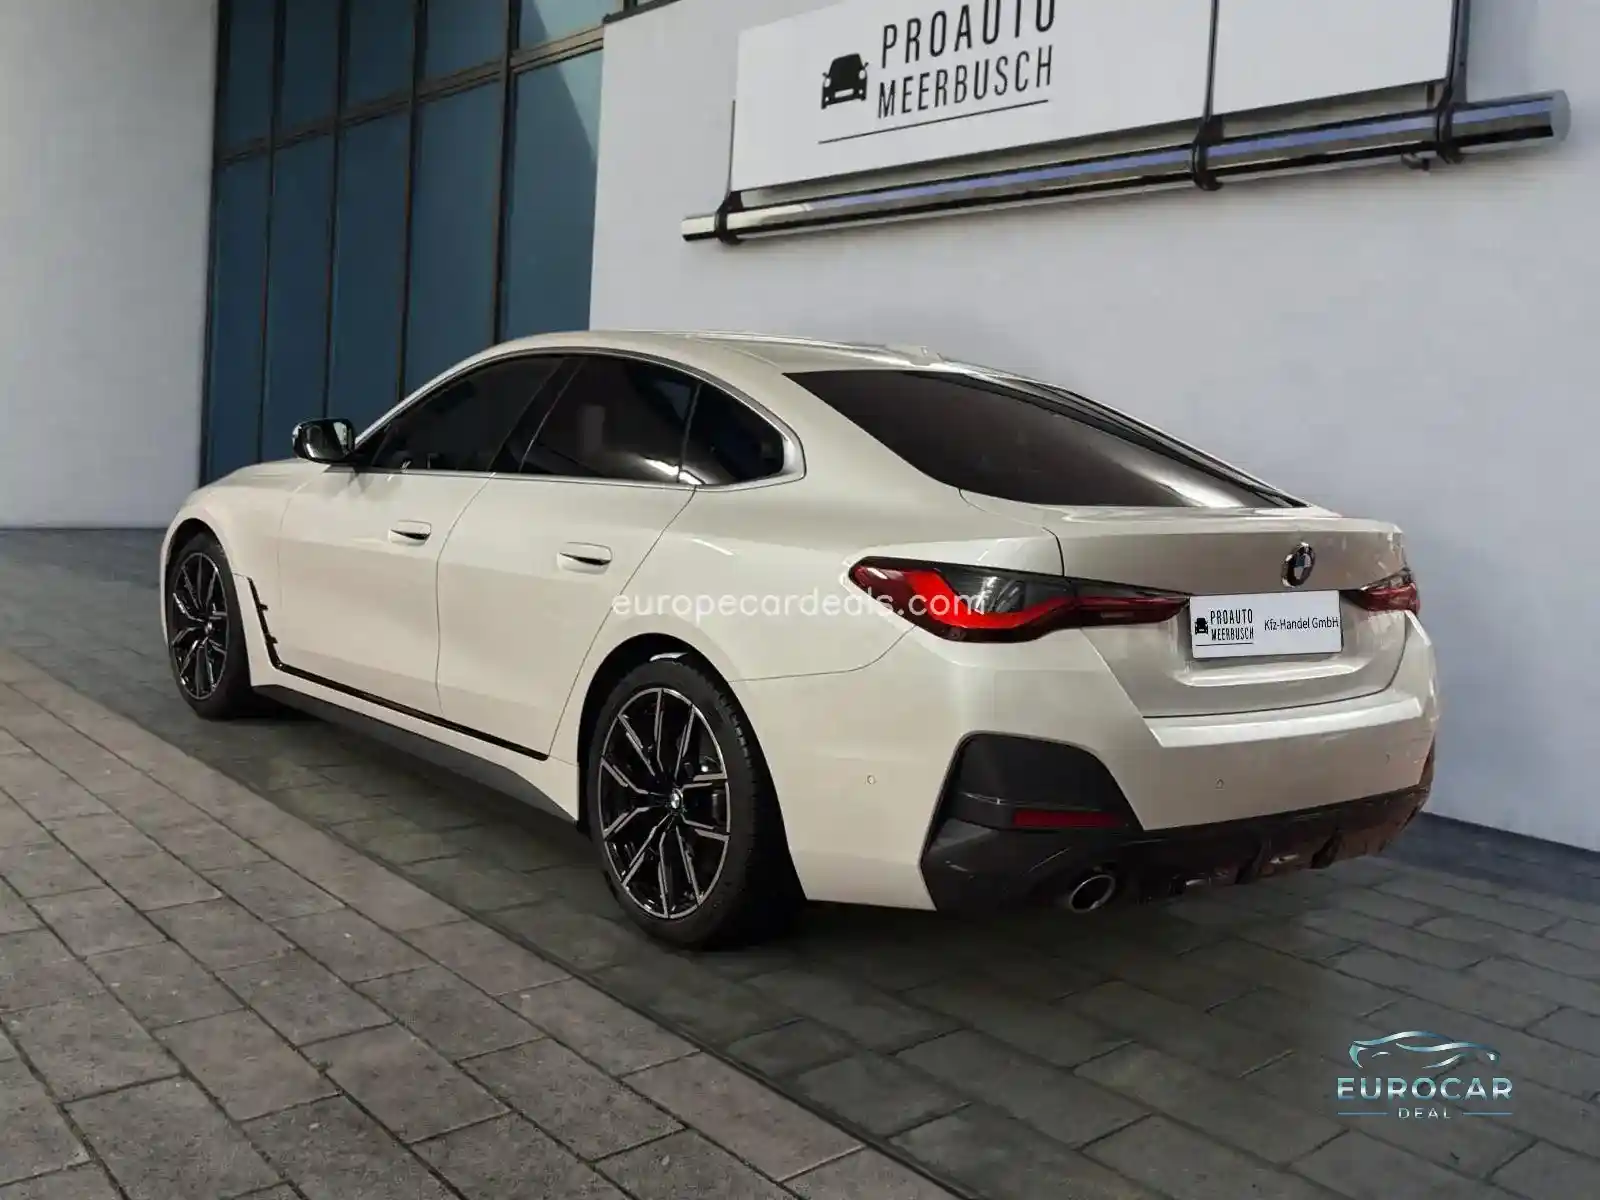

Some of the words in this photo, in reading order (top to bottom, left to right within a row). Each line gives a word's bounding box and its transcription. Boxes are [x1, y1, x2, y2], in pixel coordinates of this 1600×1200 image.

[877, 45, 1053, 119] MEERBUSCH
[1210, 608, 1253, 625] PROAUTO
[1264, 617, 1310, 631] Kfz-Handel
[1311, 616, 1339, 629] GmbH
[1211, 626, 1254, 641] MEERBUSCH
